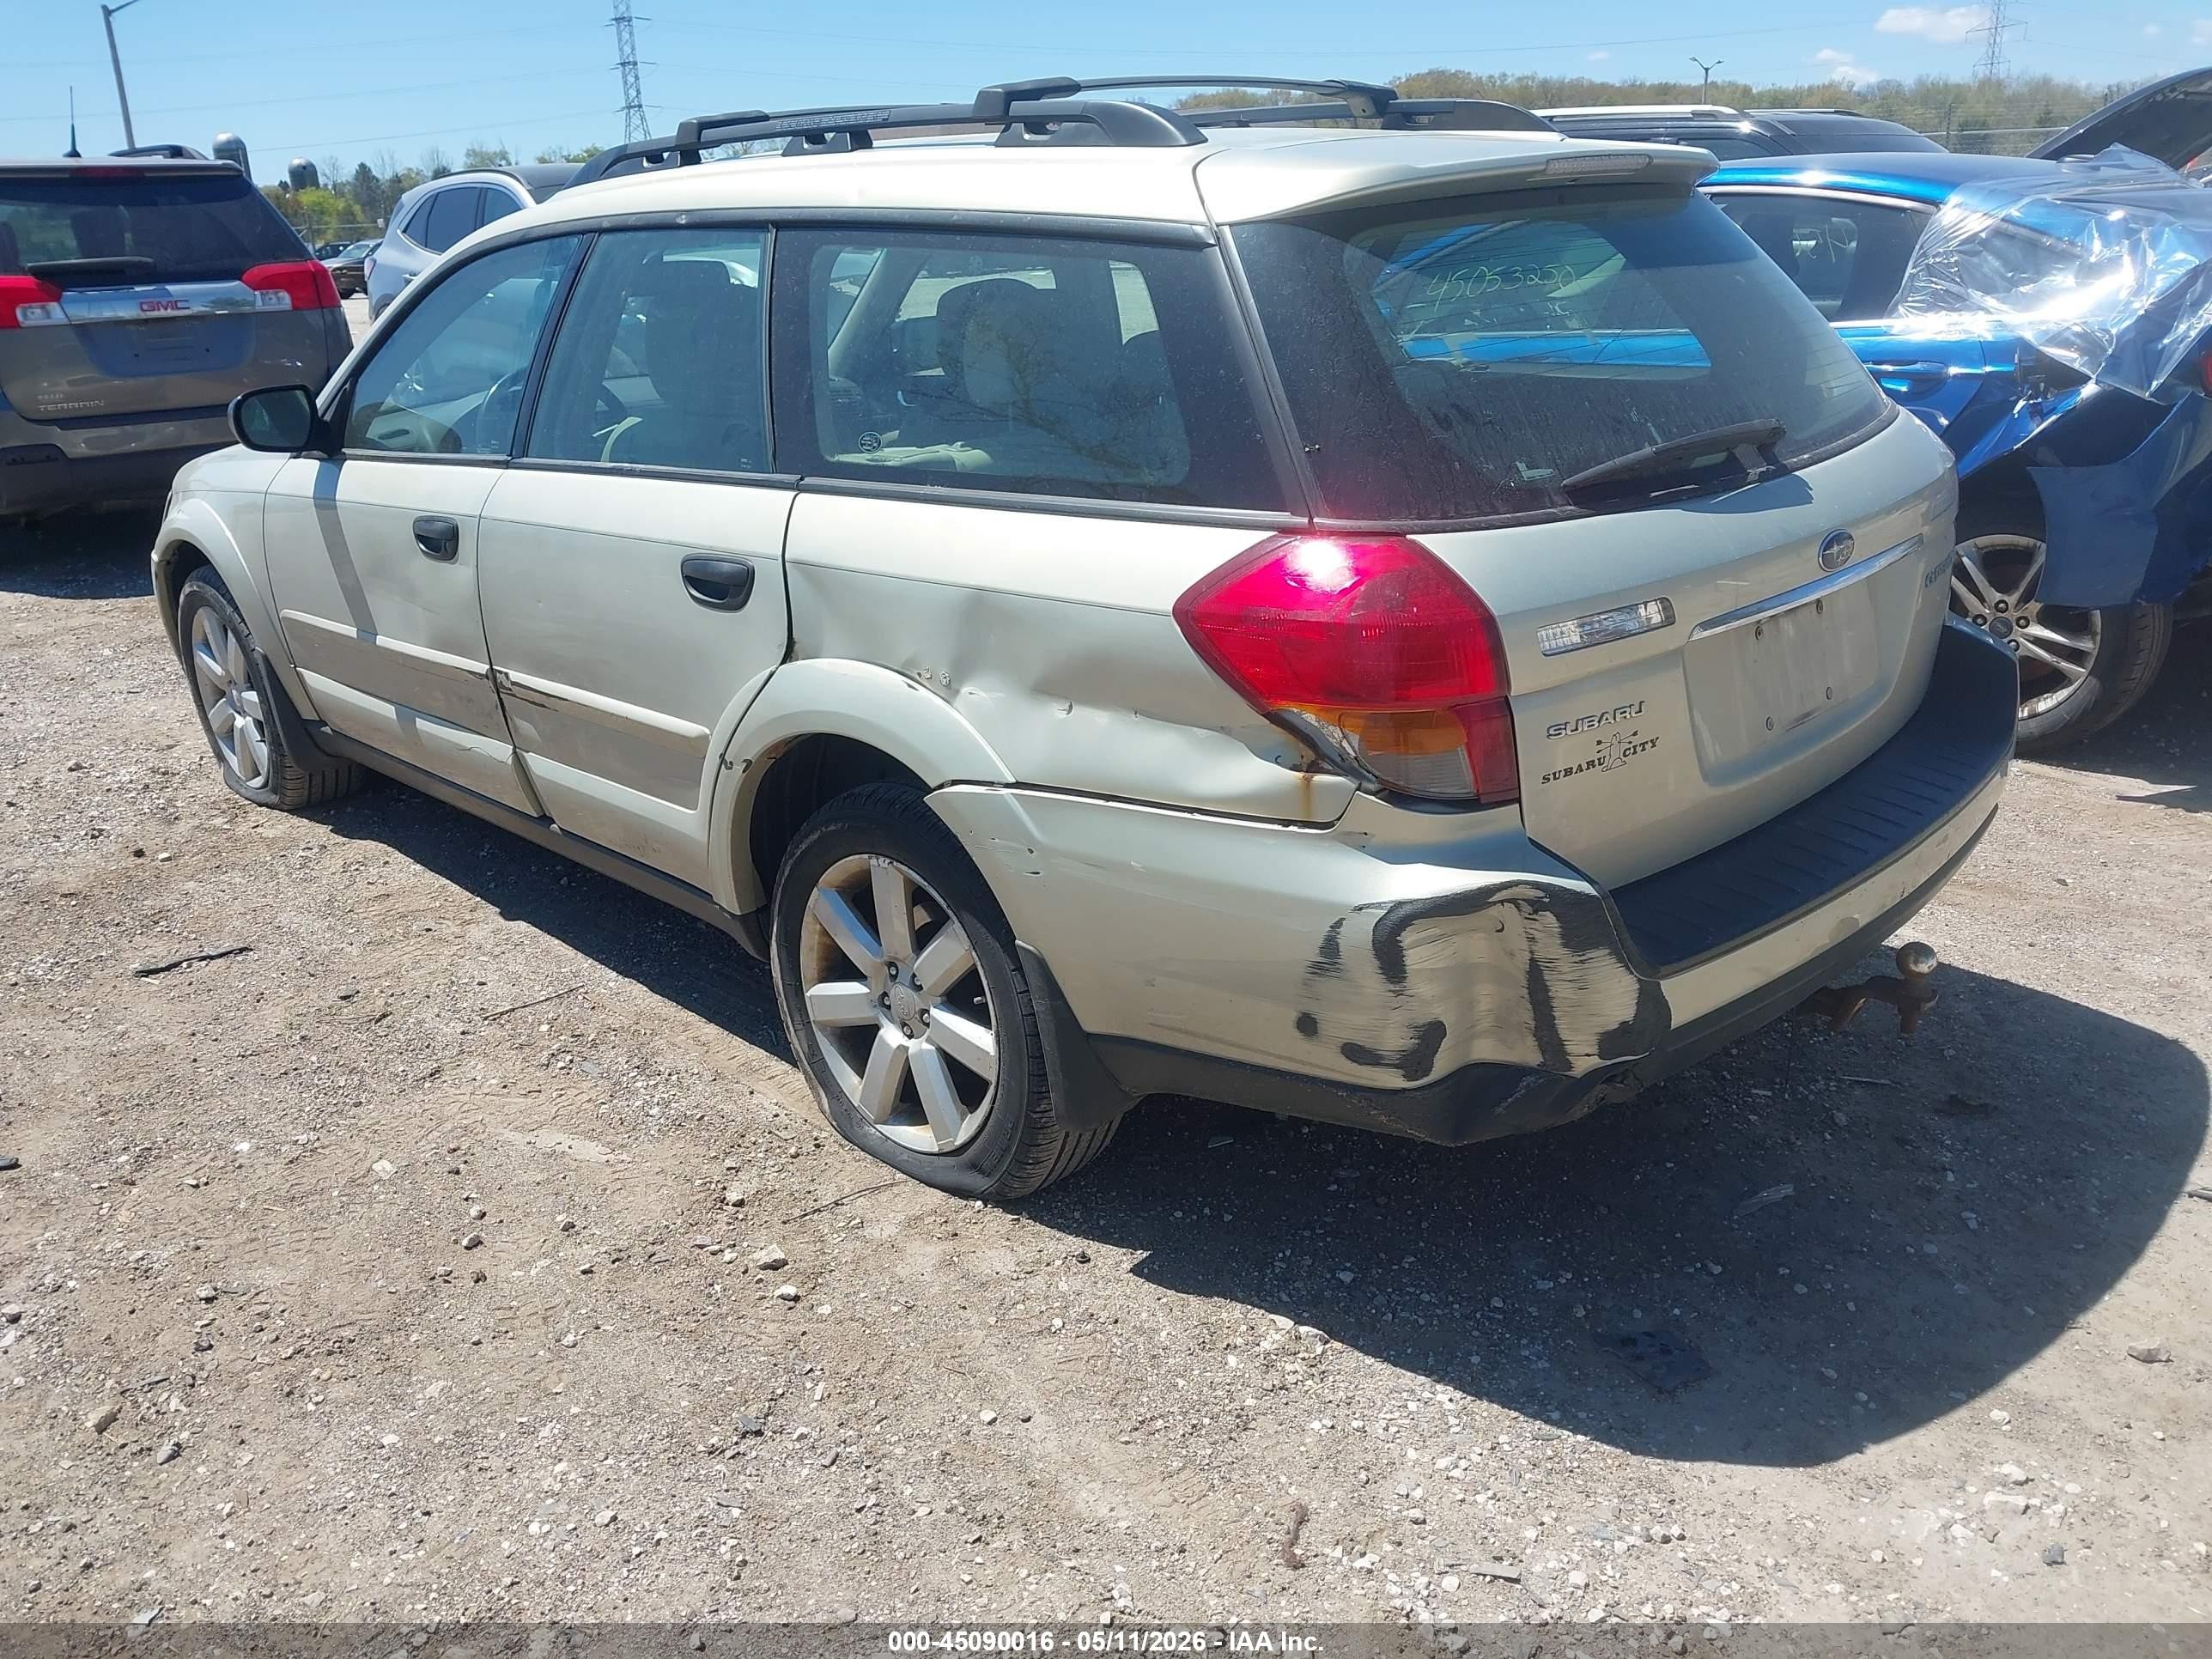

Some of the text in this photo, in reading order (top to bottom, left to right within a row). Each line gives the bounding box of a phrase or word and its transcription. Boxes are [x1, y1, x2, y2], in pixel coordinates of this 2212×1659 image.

[139, 299, 191, 313] GMC
[1426, 264, 1576, 312] 45053250
[1547, 700, 1645, 740] SUBARU
[1541, 737, 1660, 785] SUBARU CITY
